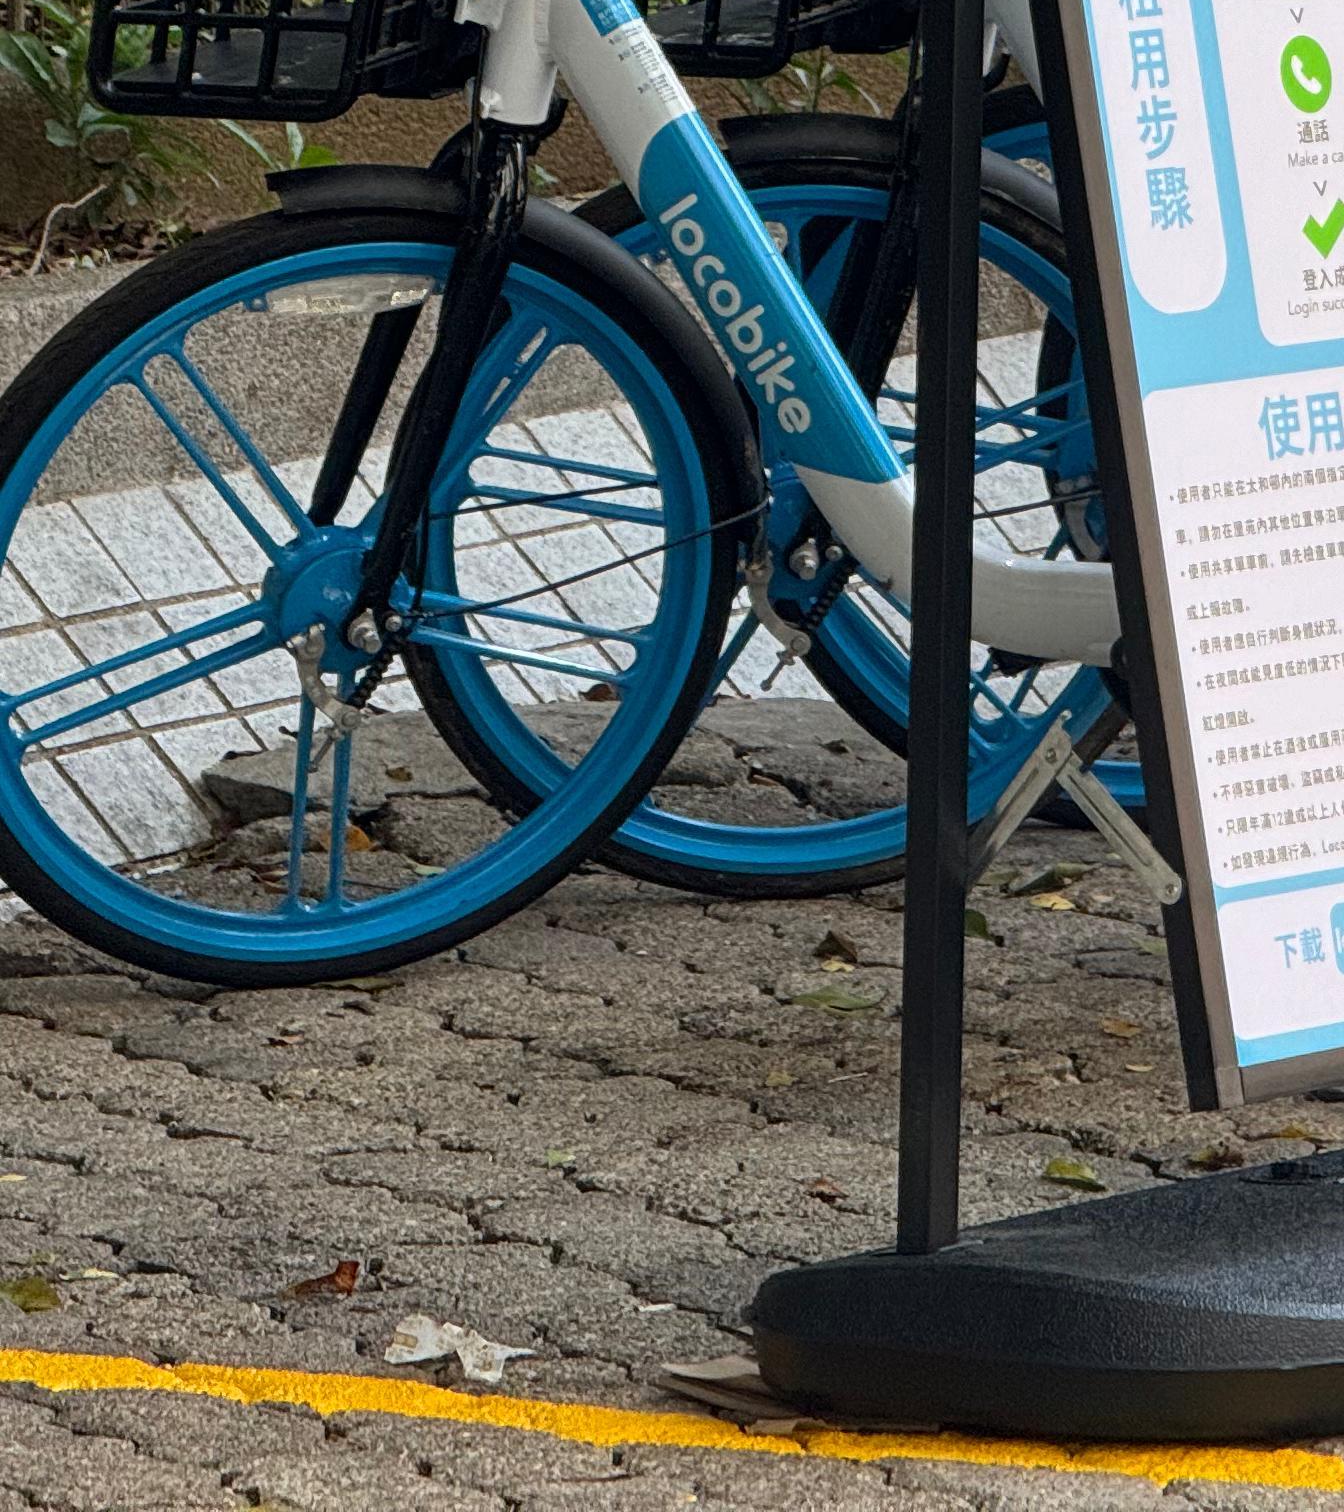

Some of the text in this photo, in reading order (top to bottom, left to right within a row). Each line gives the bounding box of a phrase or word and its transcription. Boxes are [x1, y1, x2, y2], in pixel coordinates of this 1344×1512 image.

[1295, 118, 1330, 144] 通話
[1286, 149, 1319, 169] Make
[1320, 152, 1329, 165] a
[658, 191, 812, 435] locobike
[1286, 297, 1320, 319] Login
[1273, 926, 1326, 969] 下載
